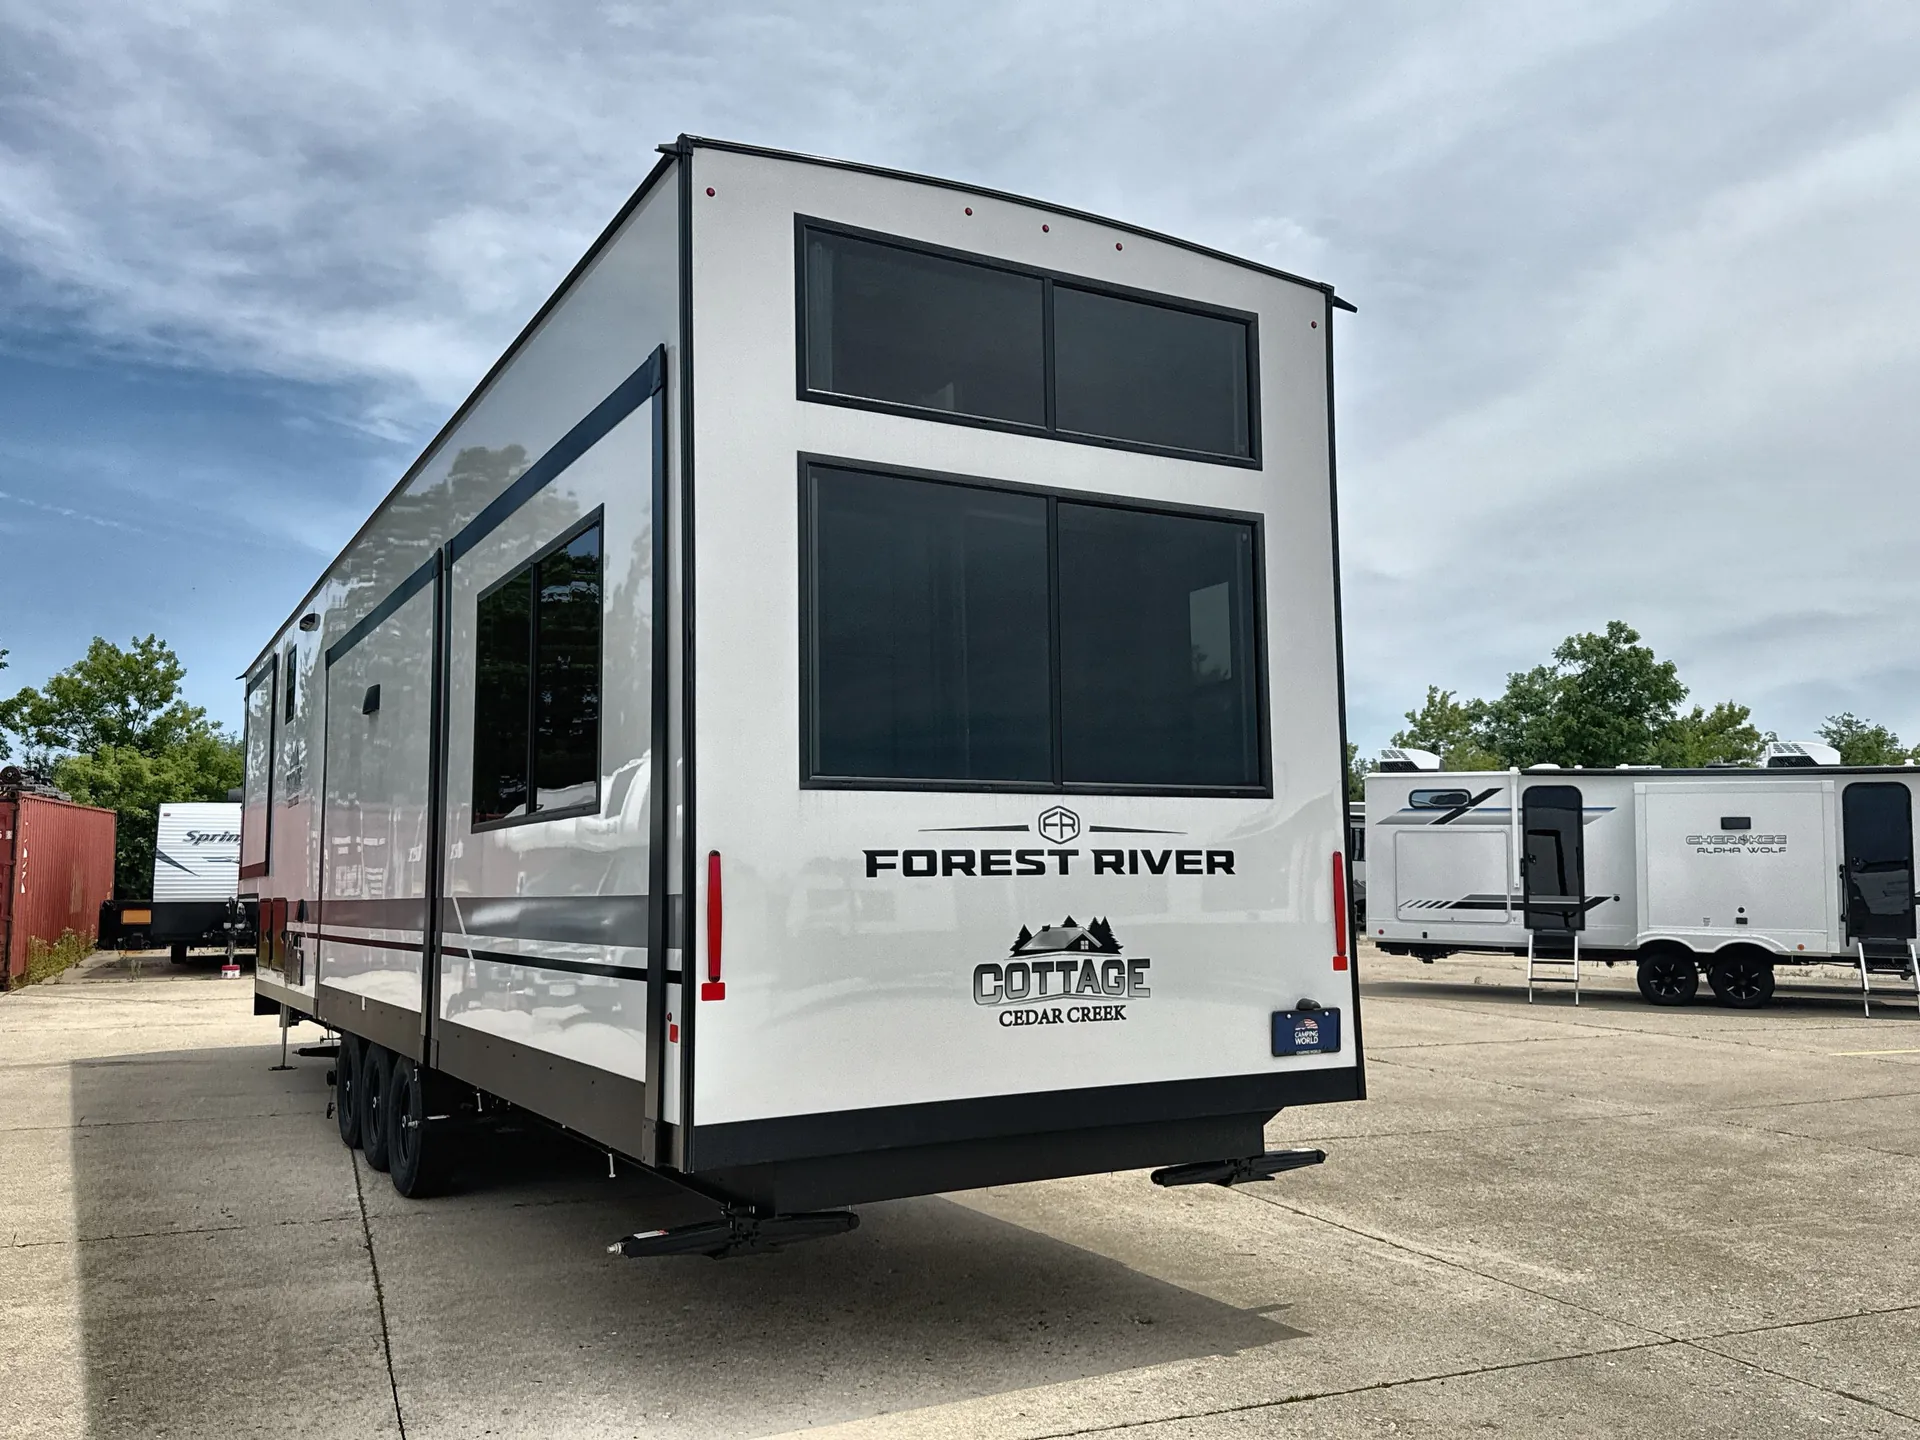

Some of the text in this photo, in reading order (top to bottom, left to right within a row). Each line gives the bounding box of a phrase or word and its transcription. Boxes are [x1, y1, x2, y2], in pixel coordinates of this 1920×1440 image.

[1043, 811, 1076, 838] FR
[183, 830, 241, 846] Sprin
[862, 848, 1236, 877] FOREST RIVER
[973, 958, 1151, 1005] COTTAGE
[999, 1005, 1127, 1027] CEDAR CREEK
[1294, 1030, 1319, 1038] CAMPING
[1294, 1036, 1319, 1045] WORLD
